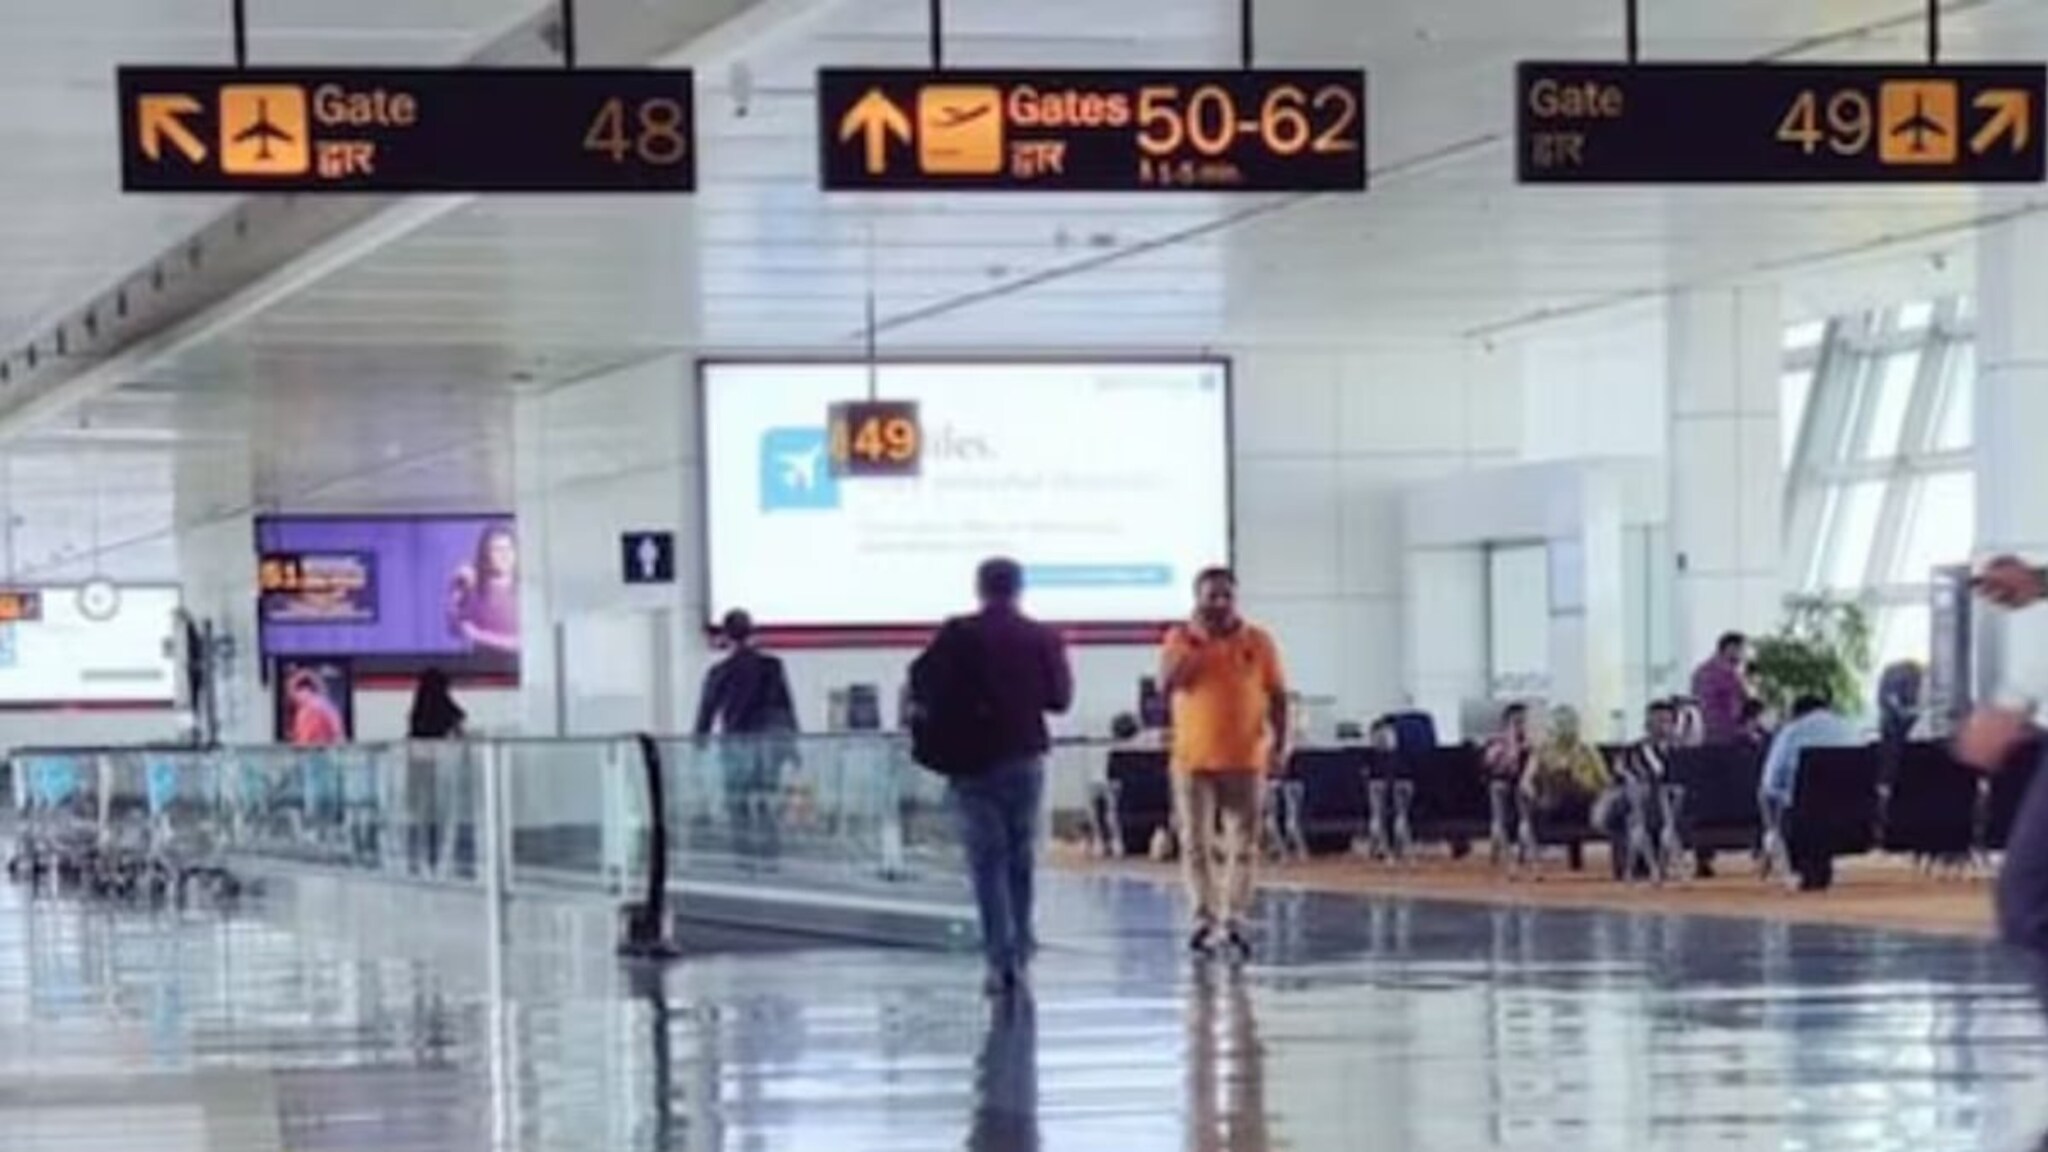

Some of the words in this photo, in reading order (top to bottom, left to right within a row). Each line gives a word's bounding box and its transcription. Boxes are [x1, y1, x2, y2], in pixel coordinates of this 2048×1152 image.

[313, 83, 417, 126] Gate
[1008, 85, 1130, 127] Gates
[1137, 84, 1357, 155] 50-62
[1529, 78, 1625, 118] Gate
[583, 97, 686, 164] 48
[1776, 89, 1870, 155] 49
[854, 417, 917, 462] 49
